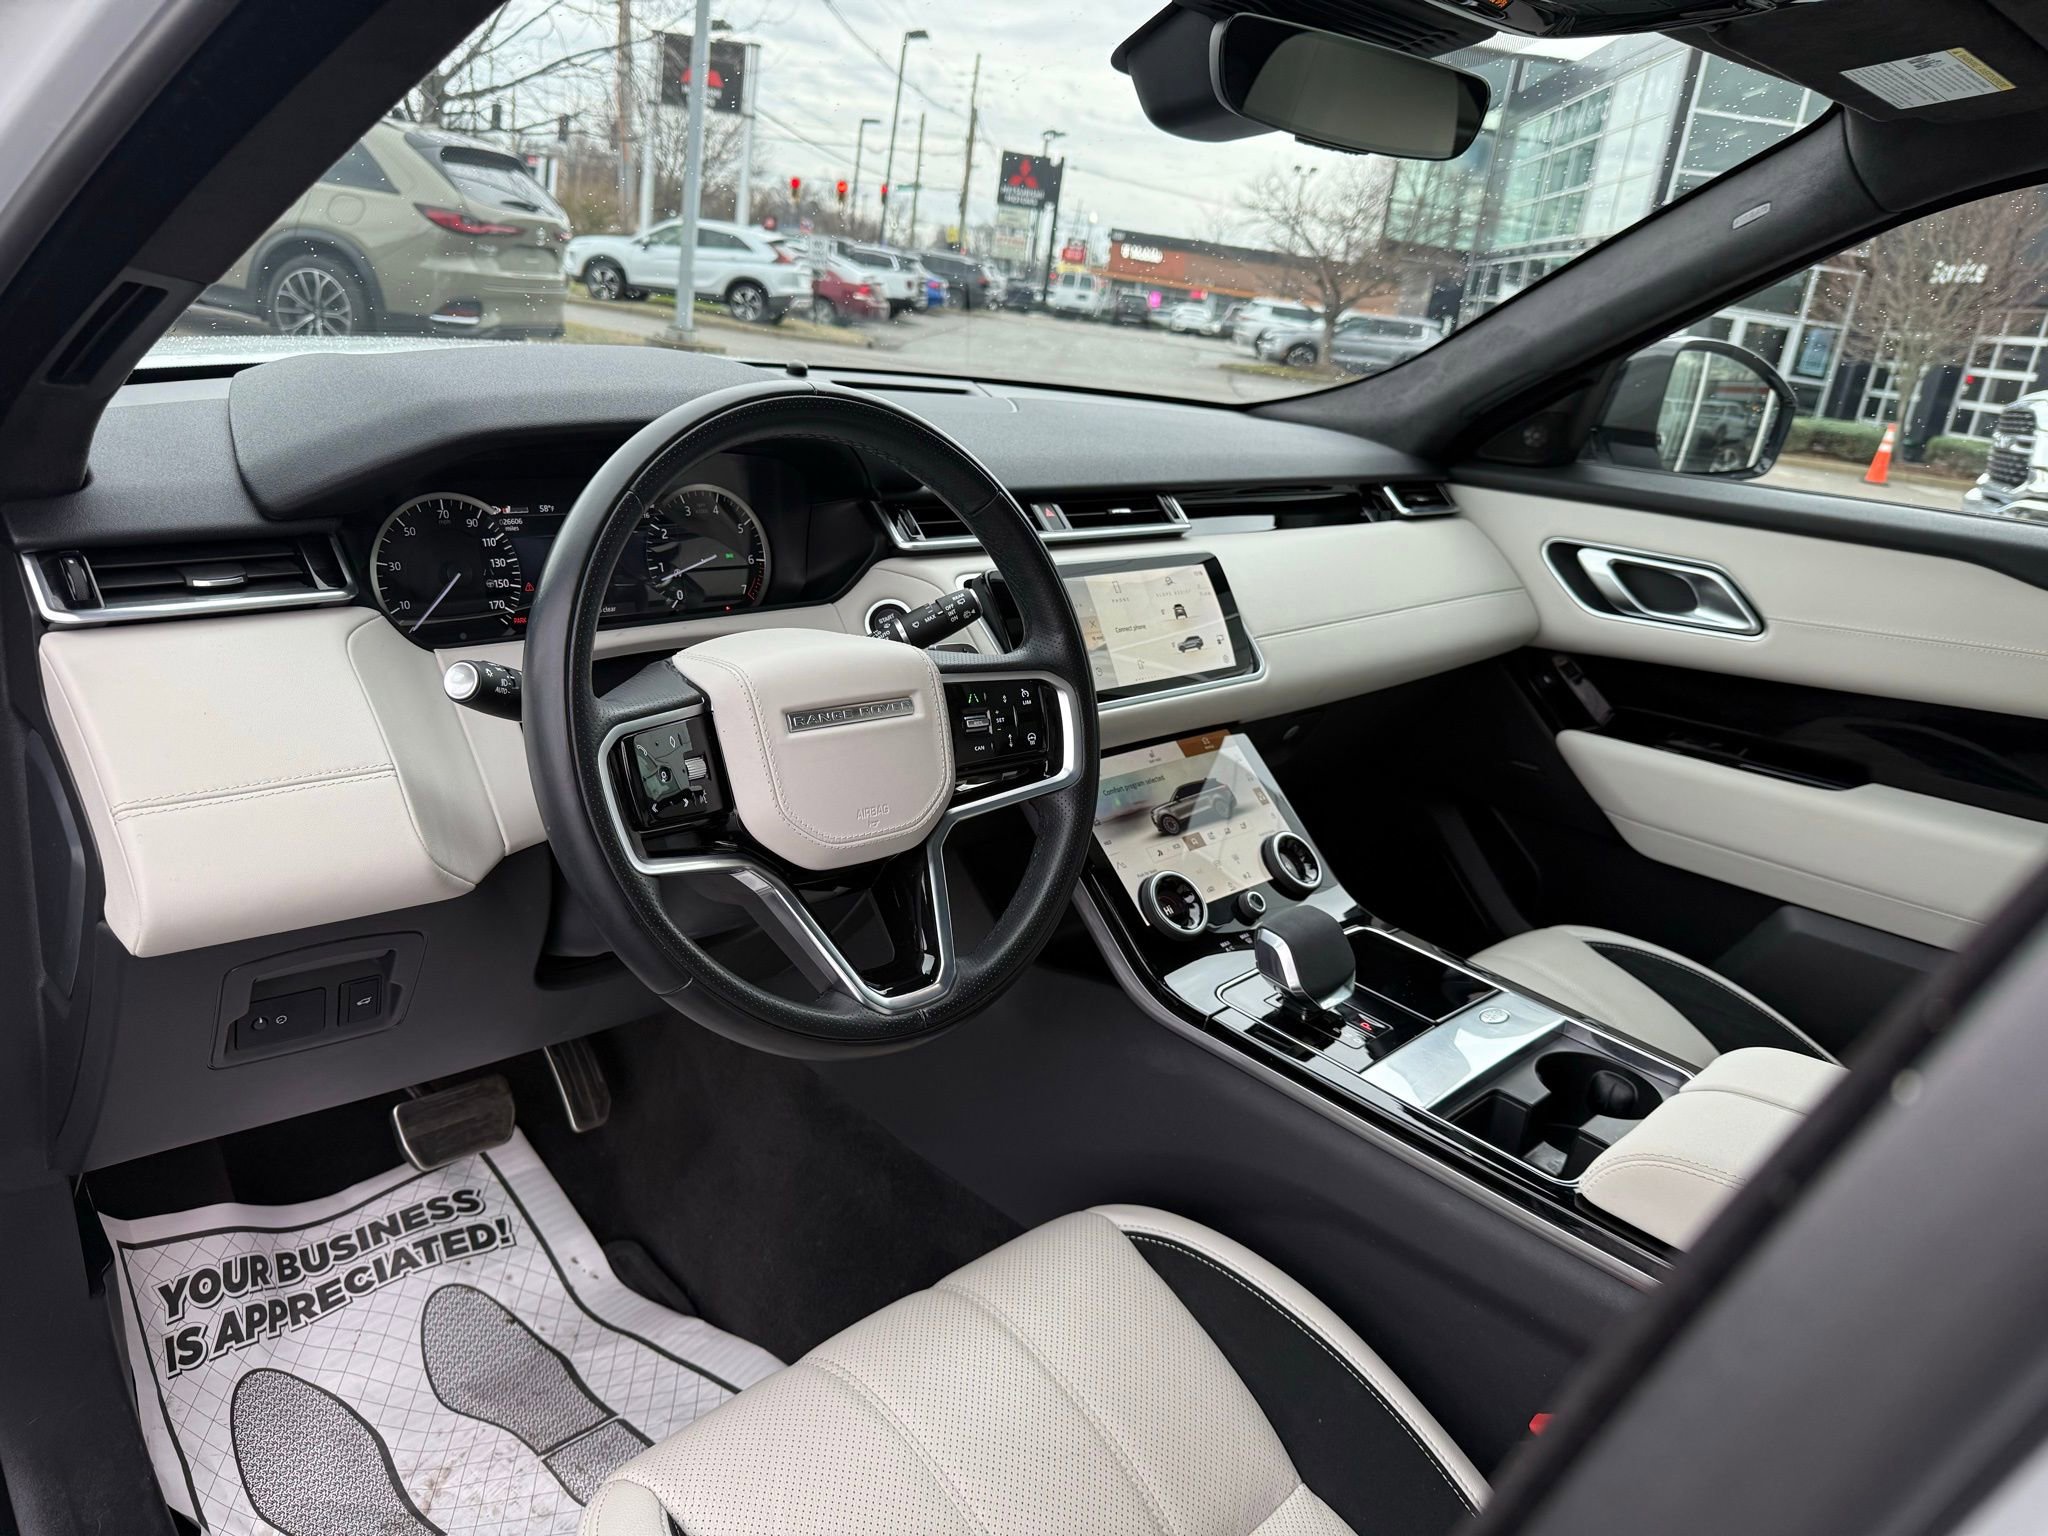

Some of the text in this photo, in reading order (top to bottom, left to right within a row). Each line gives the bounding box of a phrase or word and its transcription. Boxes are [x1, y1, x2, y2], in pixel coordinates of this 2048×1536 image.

[1929, 258, 1989, 284] Service
[436, 509, 450, 519] 70
[684, 505, 692, 517] 3
[712, 504, 720, 515] 4
[465, 518, 479, 528] 90
[737, 523, 744, 534] 5
[403, 526, 417, 537] 50
[660, 528, 669, 540] 2
[481, 537, 497, 548] 110
[490, 558, 506, 568] 130
[747, 554, 755, 565] 6
[388, 561, 402, 572] 30
[493, 579, 510, 588] 150
[676, 589, 684, 601] 0
[740, 584, 748, 595] 7
[399, 600, 411, 610] 10
[488, 599, 506, 610] 170
[944, 603, 955, 611] OFF
[878, 612, 895, 624] START
[947, 608, 957, 617] INT
[513, 616, 527, 624] PARK
[924, 614, 937, 623] MAX
[495, 686, 508, 695] AUTO
[794, 700, 912, 727] RANGE ROVER
[1102, 786, 1125, 797] Comfort
[1125, 780, 1145, 792] program
[856, 803, 890, 821] AIRBAG
[1163, 904, 1175, 916] Hi
[156, 1188, 484, 1321] YOUR BUSINESS
[164, 1217, 513, 1374] IS APPRECIATED!
